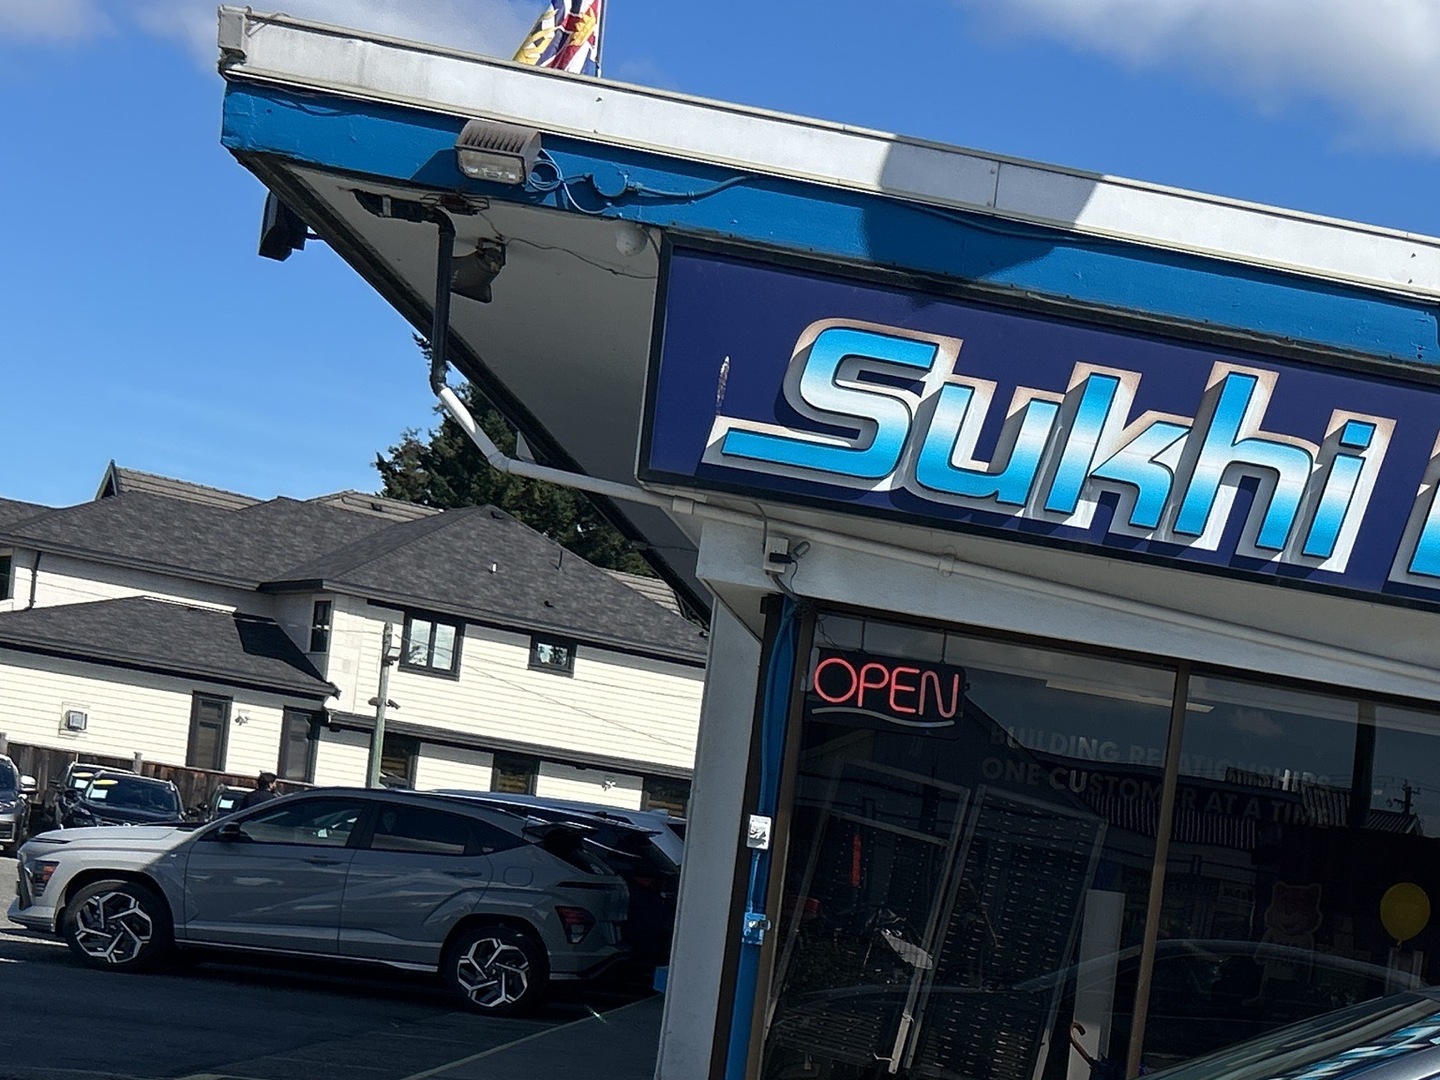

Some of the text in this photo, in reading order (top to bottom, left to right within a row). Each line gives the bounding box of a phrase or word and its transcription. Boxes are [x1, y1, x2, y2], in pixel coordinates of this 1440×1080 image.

[702, 318, 1396, 573] Sukhi
[813, 656, 960, 719] OPEN
[981, 756, 1042, 786] ONE
[1203, 791, 1238, 815] AT
[1128, 745, 1331, 797] REATIONSHIPS
